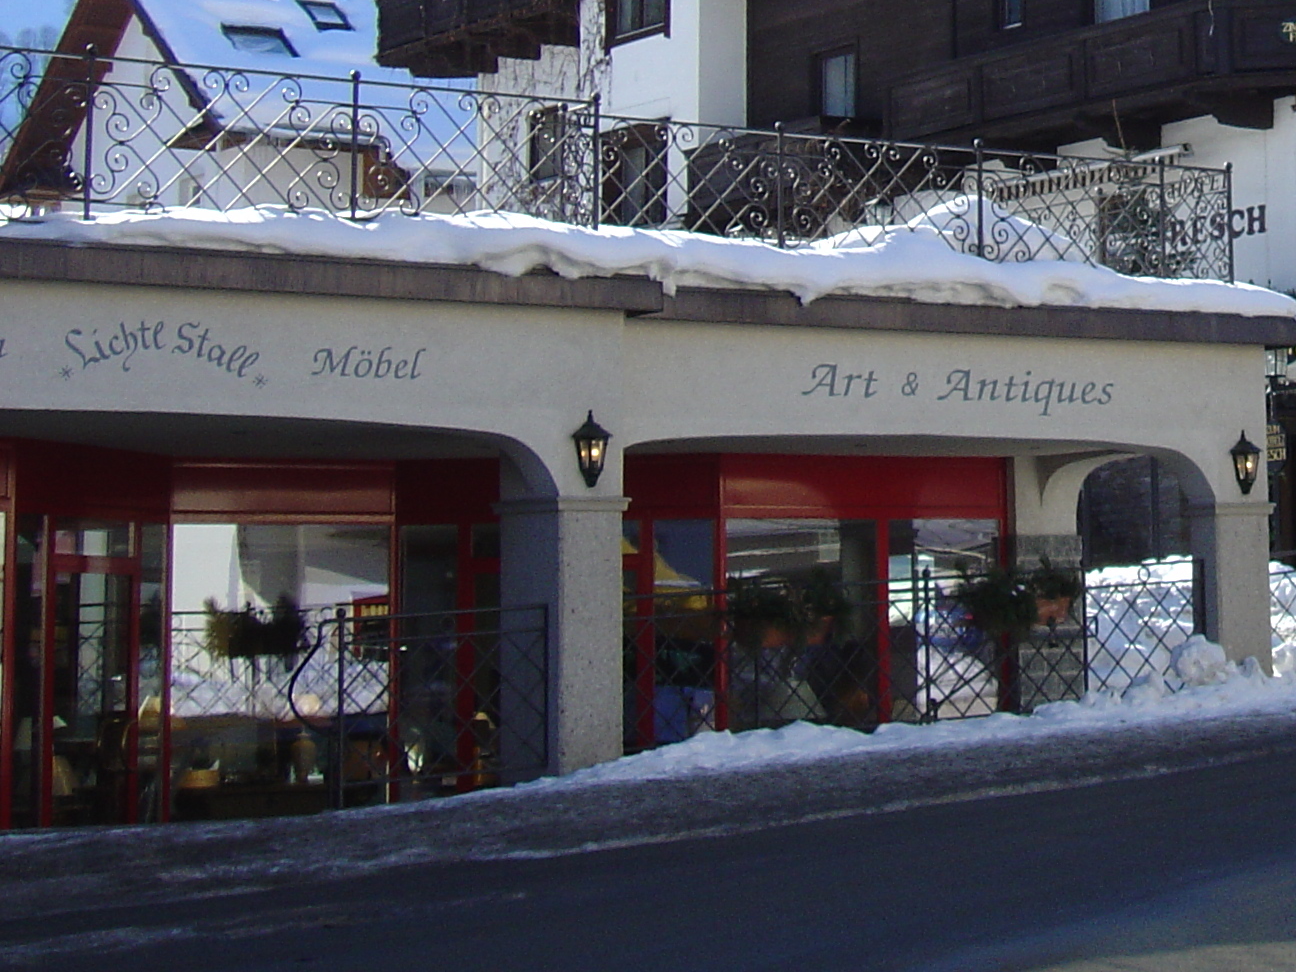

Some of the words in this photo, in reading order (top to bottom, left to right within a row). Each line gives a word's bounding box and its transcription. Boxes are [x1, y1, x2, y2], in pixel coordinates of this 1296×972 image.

[1170, 204, 1267, 247] RESCH
[65, 321, 166, 372] Lichte
[171, 322, 260, 378] Stall
[310, 345, 427, 380] Möbel
[801, 363, 879, 399] Art
[900, 371, 920, 397] &
[936, 368, 1116, 417] Antiques
